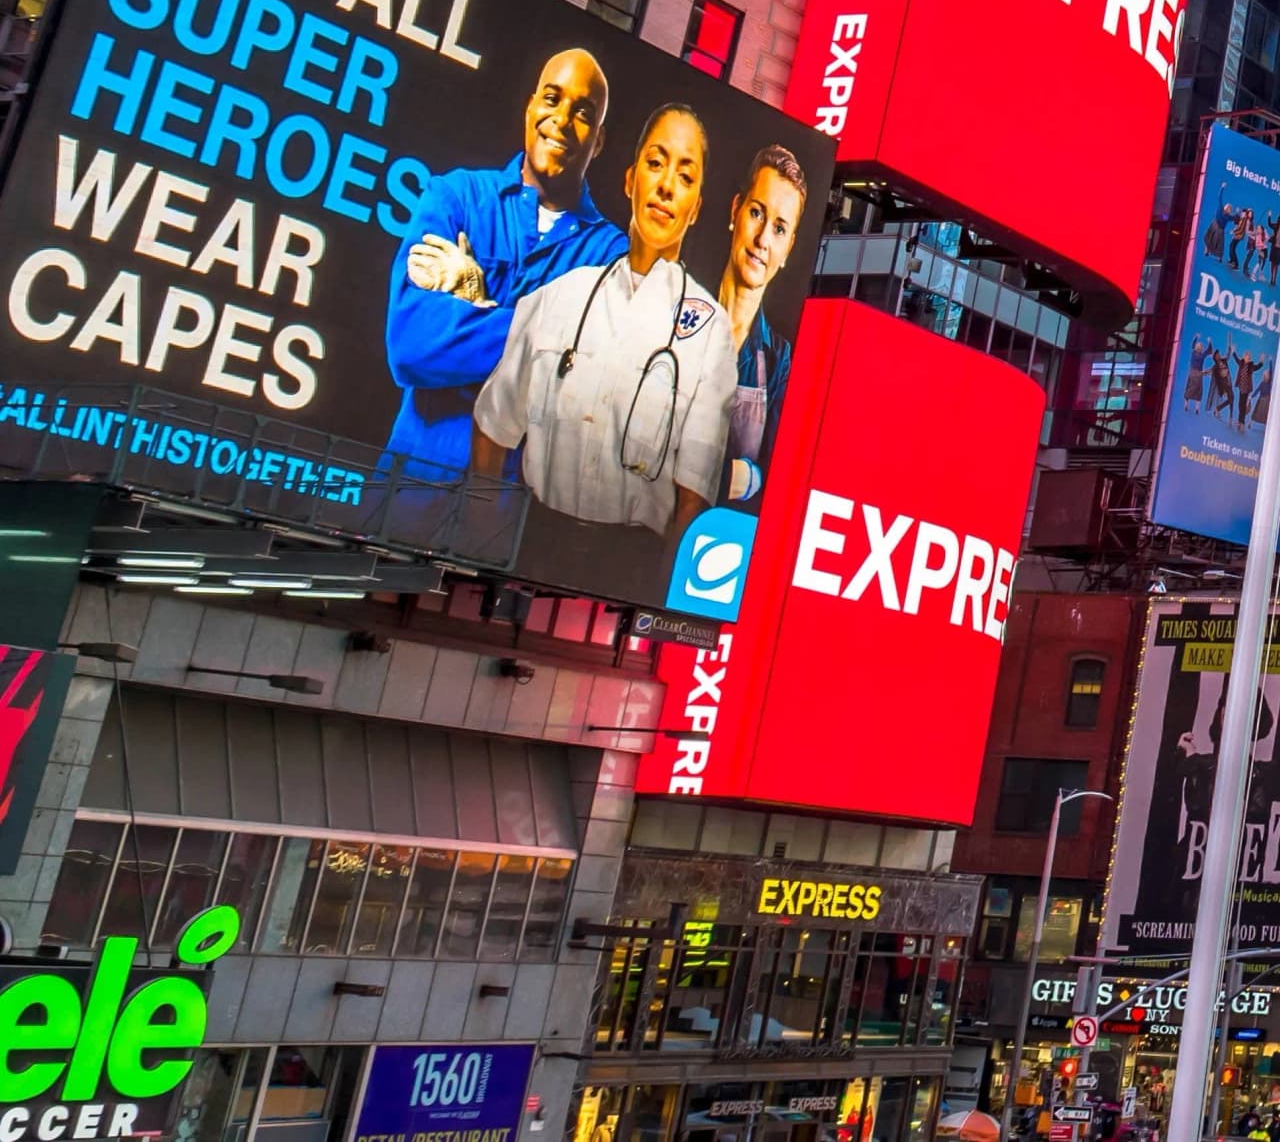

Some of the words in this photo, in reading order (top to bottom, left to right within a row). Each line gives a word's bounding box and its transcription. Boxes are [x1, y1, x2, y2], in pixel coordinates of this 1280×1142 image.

[70, 33, 435, 240] HEROES
[1226, 159, 1242, 178] Big
[1243, 166, 1269, 189] heart,
[52, 134, 327, 306] WEAR
[8, 249, 326, 411] CAPES
[0, 383, 366, 506] ALLINTHISTOGETHER
[792, 489, 1020, 646] EXPRE
[1162, 620, 1198, 639] TIMES
[1200, 620, 1238, 638] SQUA
[1188, 648, 1226, 666] MAKE
[757, 878, 884, 922] EXPRESS
[1032, 979, 1113, 1007] GIFS
[410, 1052, 482, 1107] 1560
[476, 1053, 493, 1104] BROADWAY
